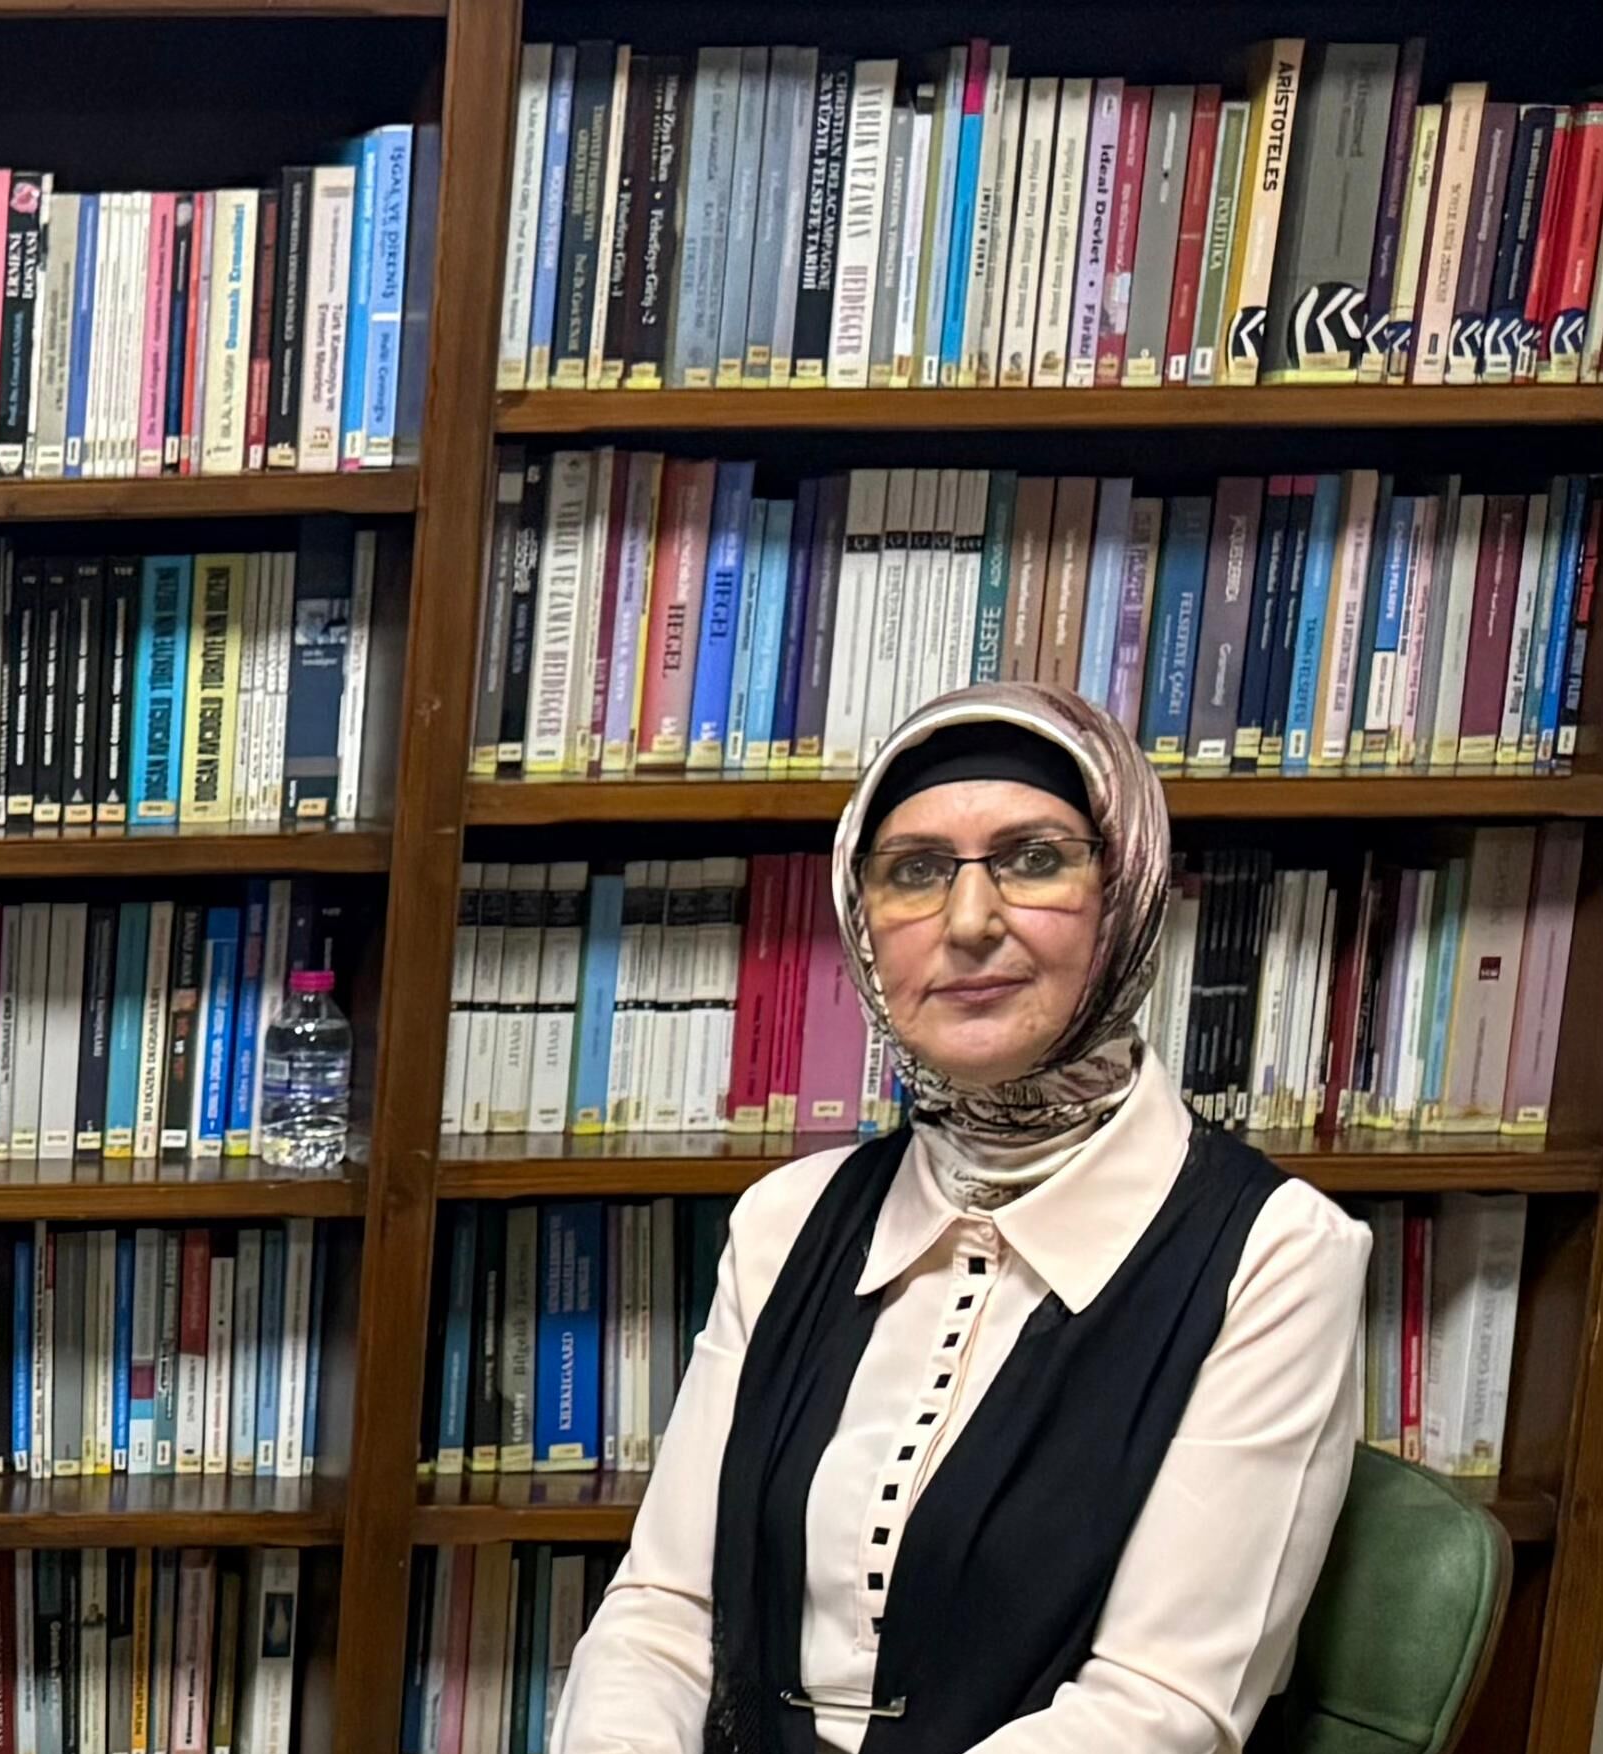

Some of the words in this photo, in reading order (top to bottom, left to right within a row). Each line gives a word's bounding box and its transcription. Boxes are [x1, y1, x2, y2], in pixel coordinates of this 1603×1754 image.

[661, 114, 676, 142] Ziya
[832, 71, 849, 157] CHRISTIAN
[854, 87, 882, 150] VARLIK
[1262, 61, 1295, 192] ARİSTOTELES
[658, 145, 675, 182] Ülken
[807, 159, 825, 228] FELSEFE
[853, 156, 876, 179] VE
[1096, 144, 1114, 194] İdeal
[387, 202, 400, 222] VE
[615, 192, 631, 249] Felsefeye
[648, 209, 665, 271] Felsefeye
[818, 159, 840, 289] DELACAMPAGNE
[847, 182, 875, 239] ZAMAN
[1088, 200, 1107, 266] Devlet
[6, 232, 22, 298] ERMENİ
[22, 231, 38, 299] DOSYASI
[228, 203, 247, 283] Ermenileri
[611, 252, 627, 282] Giriş
[224, 287, 240, 350] Osmanlı
[331, 303, 343, 331] Türk
[641, 274, 659, 308] Giriş
[836, 265, 869, 356] HEIDEGGER
[316, 303, 328, 348] Ermeni
[326, 398, 337, 412] ve
[554, 499, 580, 559] VARLIK
[552, 564, 576, 586] VE
[546, 591, 575, 646] ZAMAN
[709, 570, 736, 646] HEGEL
[1172, 591, 1193, 667] FELSEFEYE
[661, 604, 685, 679] HEGEL
[975, 606, 1002, 683] FELSEFE
[536, 649, 570, 738] HEIDEGGER
[1167, 670, 1186, 715] ÇAĞRI
[142, 1105, 155, 1122] BU
[559, 1331, 574, 1431] KIERKEGAARD
